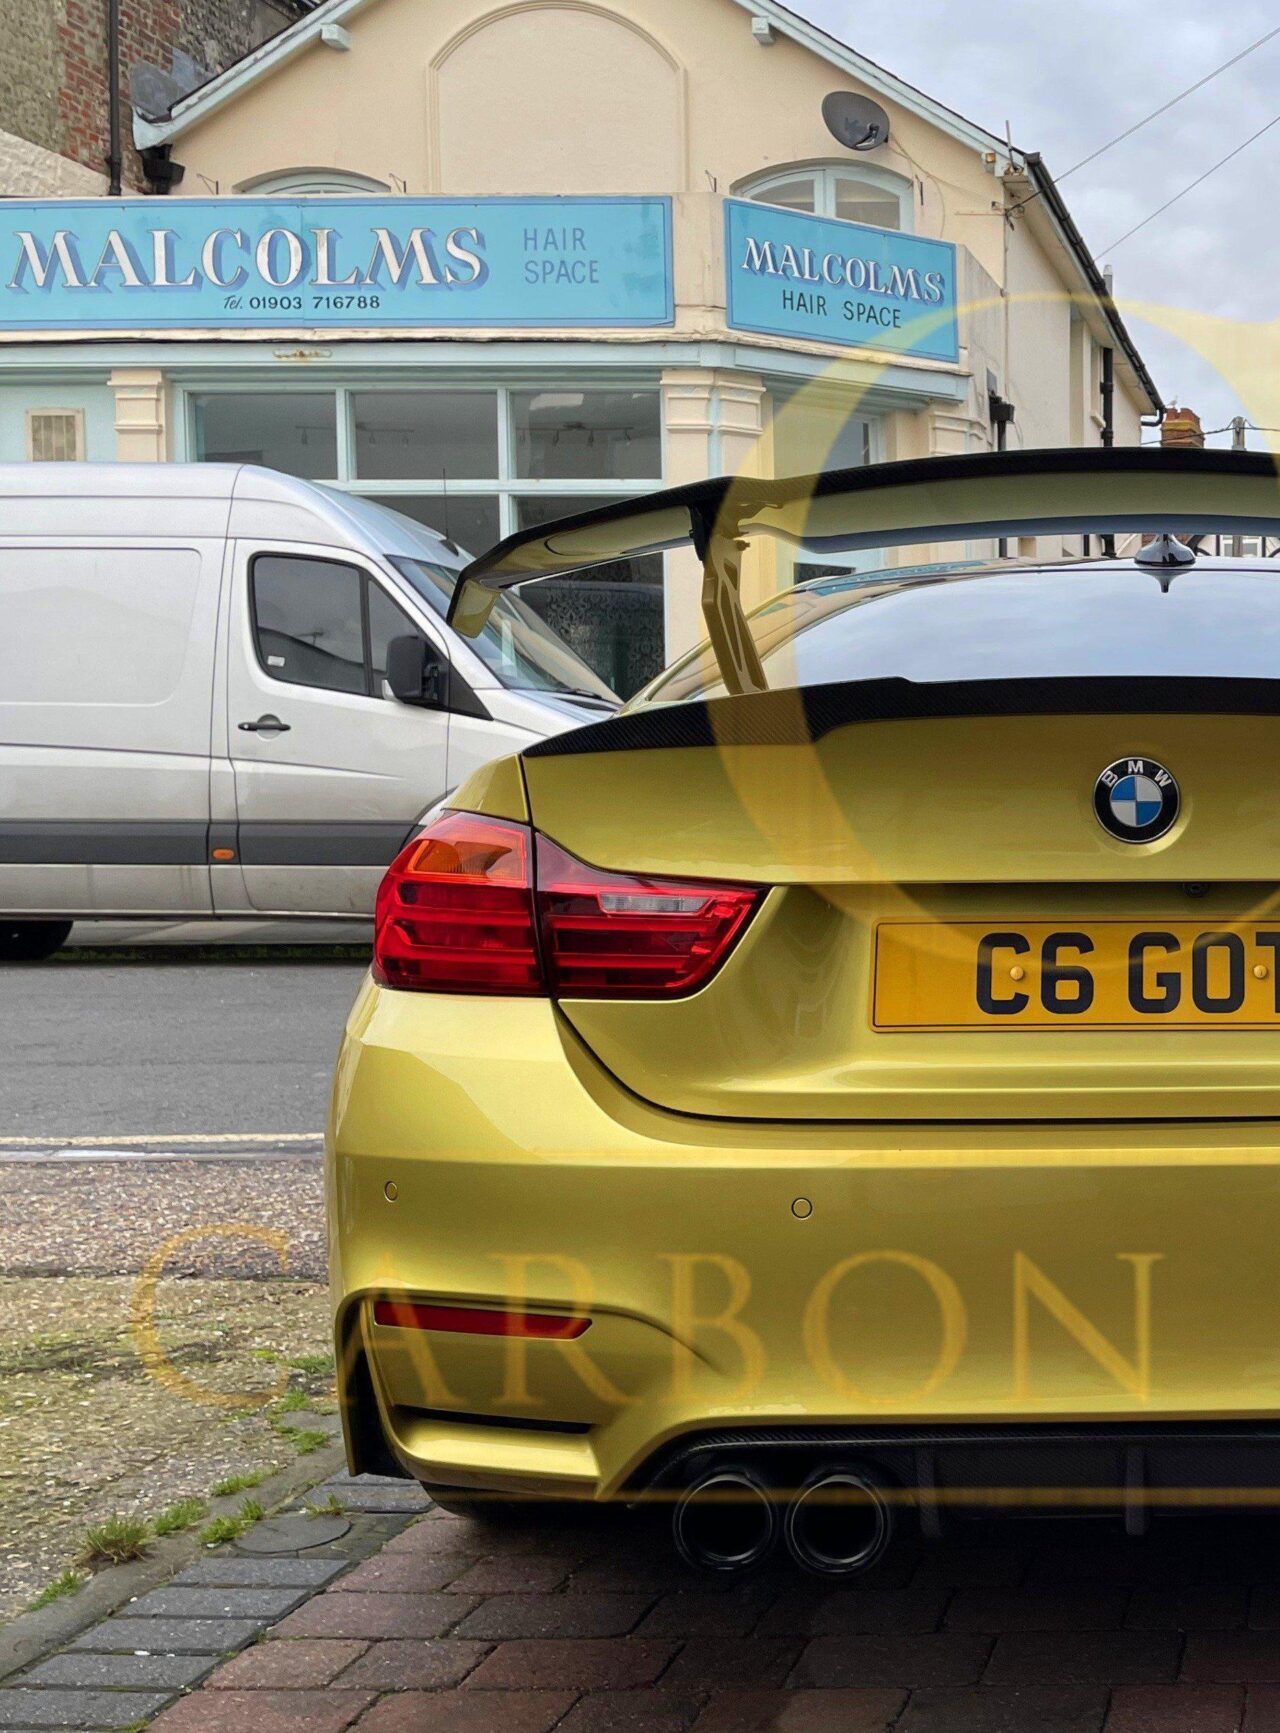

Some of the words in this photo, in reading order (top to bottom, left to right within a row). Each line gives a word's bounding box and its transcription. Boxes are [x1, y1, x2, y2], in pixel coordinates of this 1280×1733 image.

[523, 227, 586, 251] HAIR
[5, 227, 486, 289] MALCOLMS
[524, 259, 600, 284] SPACE
[741, 237, 945, 304] MALCOLMS
[223, 295, 243, 310] Tel.
[249, 297, 302, 310] 01903
[313, 295, 380, 309] 716788
[782, 289, 828, 316] HAIR
[843, 300, 902, 328] SPACE
[1101, 760, 1172, 788] BMW
[976, 932, 1095, 1015] C6
